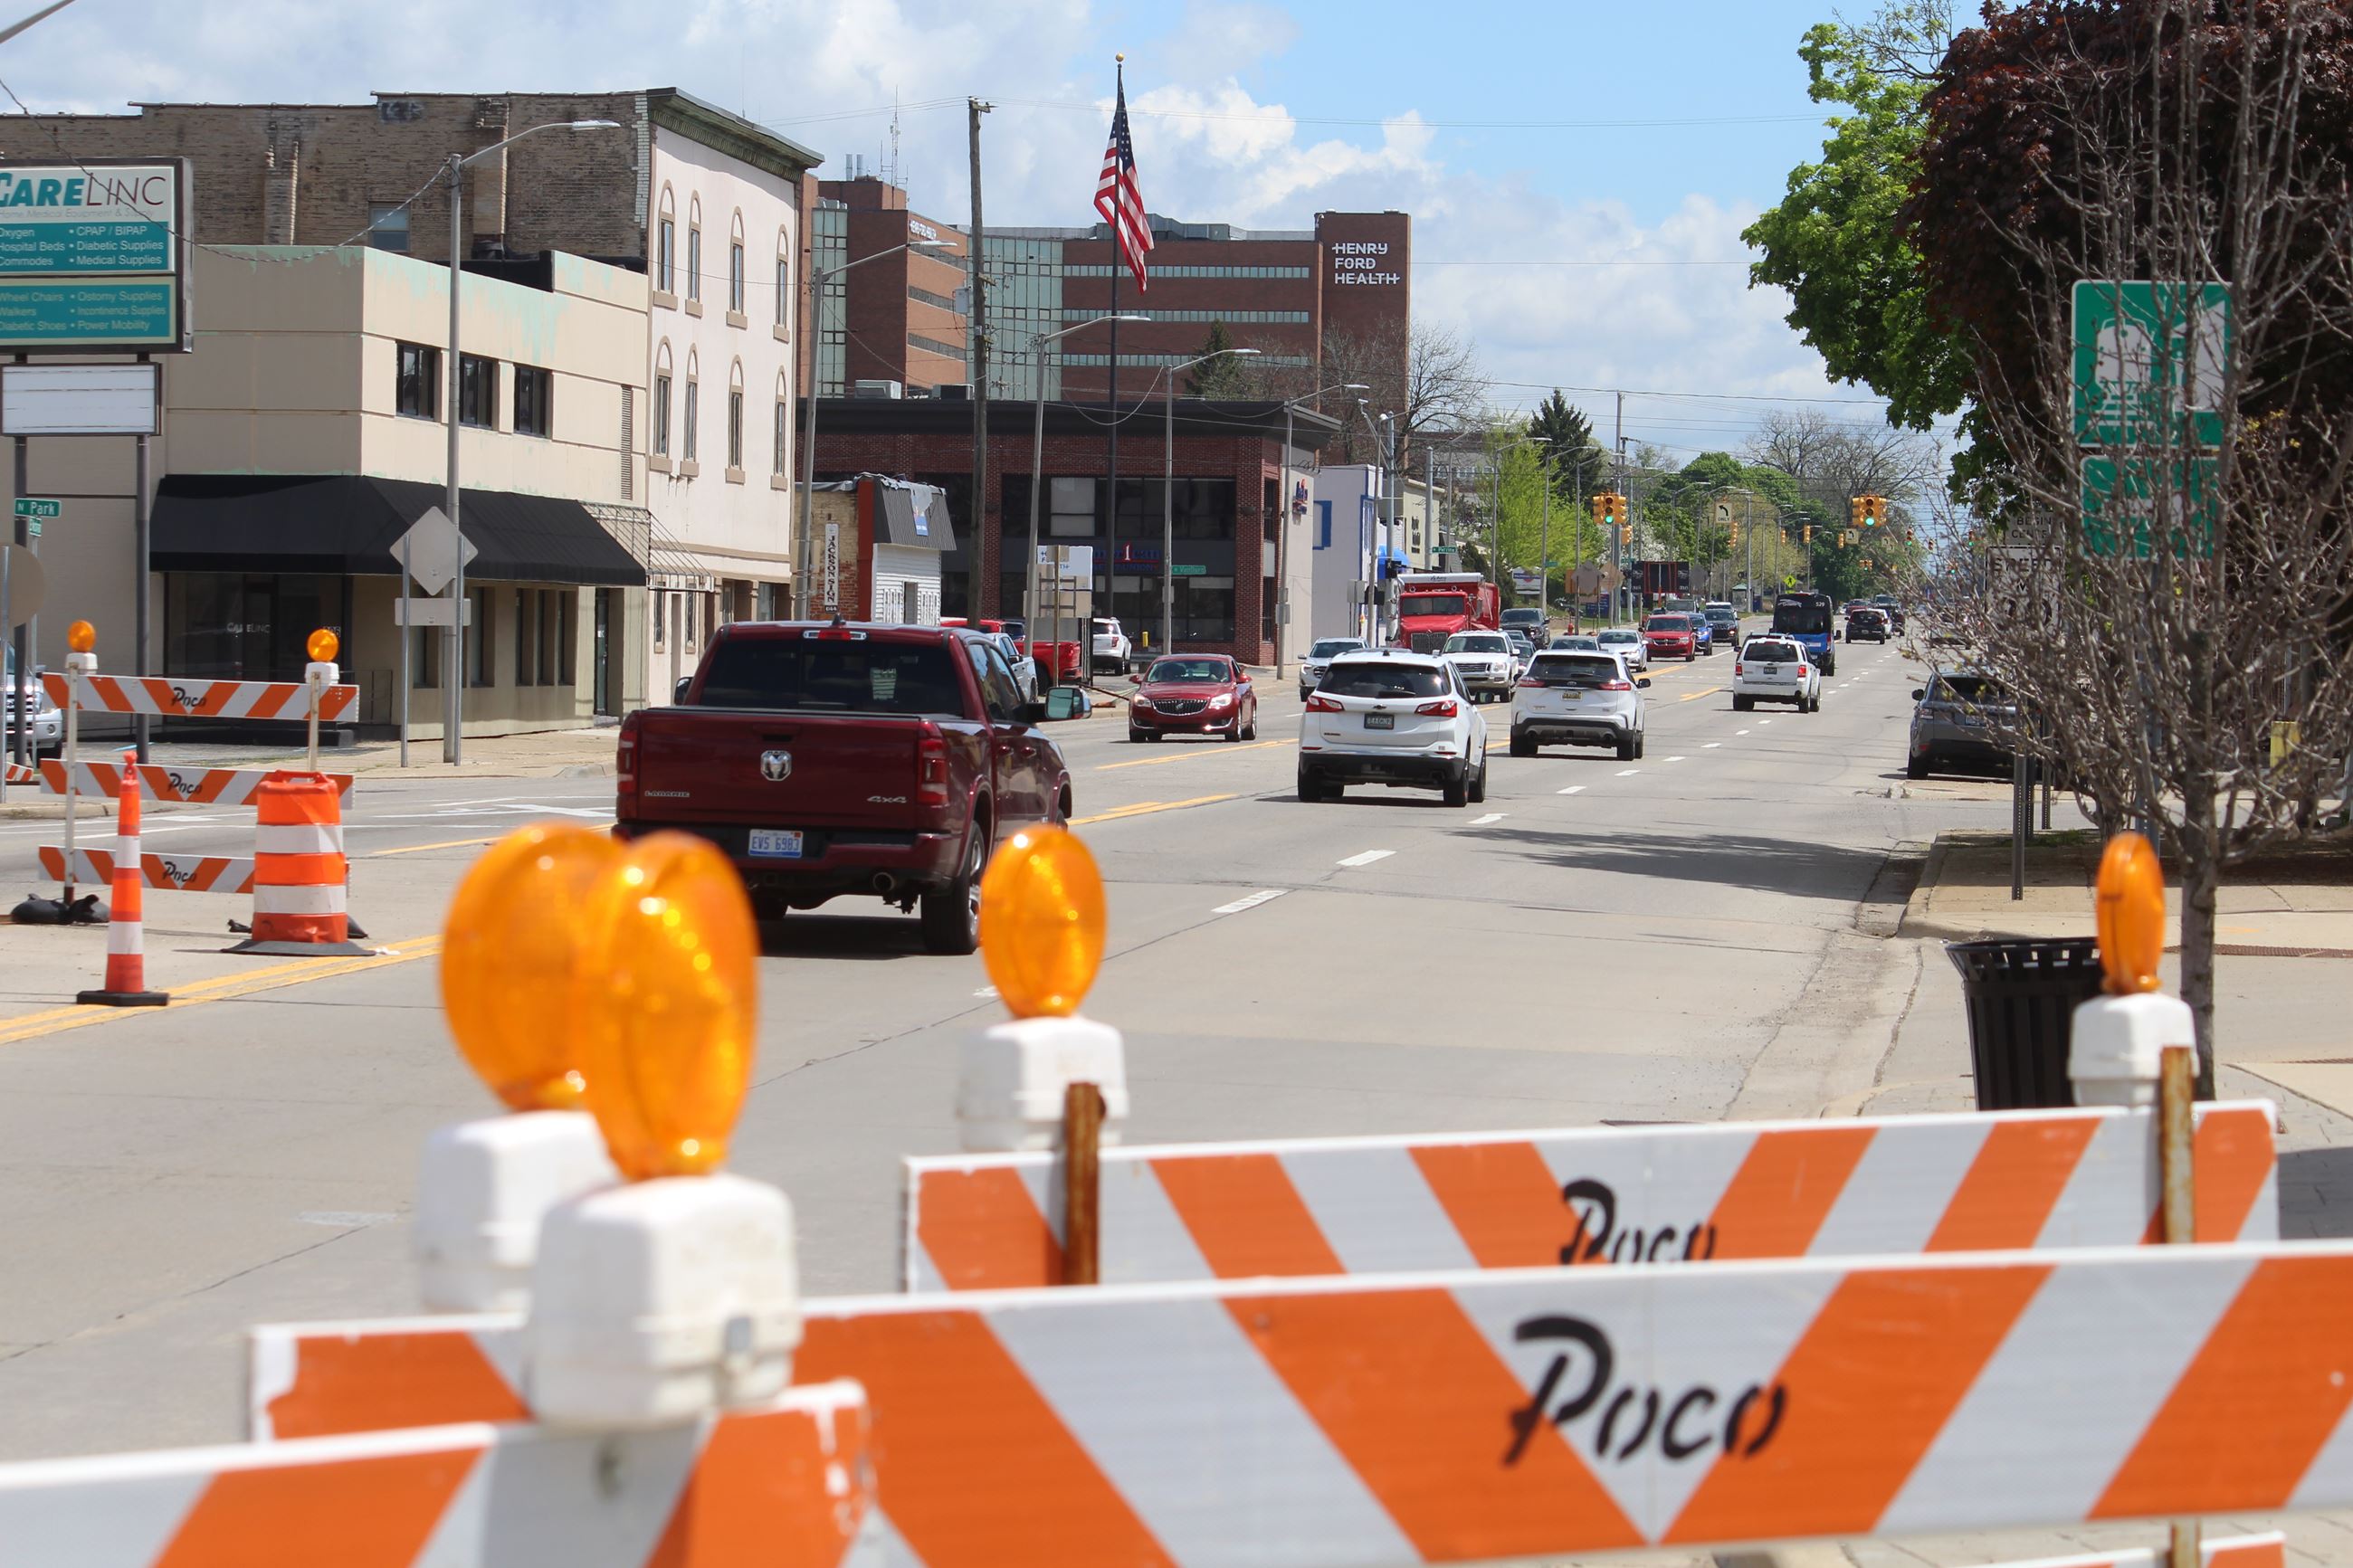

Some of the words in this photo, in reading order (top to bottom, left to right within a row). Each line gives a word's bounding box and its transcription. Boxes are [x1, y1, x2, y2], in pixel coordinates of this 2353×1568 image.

[26, 209, 60, 218] Medical
[66, 208, 112, 219] Equipment
[76, 226, 106, 236] CPAP
[115, 225, 148, 235] BIPAP
[39, 242, 65, 252] Beds
[77, 241, 119, 251] Diabetic
[119, 240, 165, 252] Supplies
[1332, 242, 1388, 254] HENRY
[77, 256, 117, 265] Medical
[119, 254, 162, 267] Supplies
[1335, 257, 1376, 269] FORD
[1334, 272, 1400, 284] HEALTH
[31, 291, 64, 301] Chairs
[77, 291, 117, 302] Ostomy
[119, 290, 163, 301] Supplies
[77, 306, 129, 316] Incontinence
[130, 305, 166, 316] Supplies
[37, 320, 67, 330] Shoes
[78, 320, 109, 329] Power
[111, 319, 150, 331] Mobility
[18, 502, 24, 512] N
[30, 501, 55, 516] Park
[827, 536, 836, 577] JACKSON
[826, 578, 835, 603] SIGN
[170, 686, 207, 708] Poco
[167, 772, 203, 794] Poco
[752, 836, 769, 850] EVS
[162, 860, 197, 884] Poco
[1500, 1314, 1788, 1468] Poco
